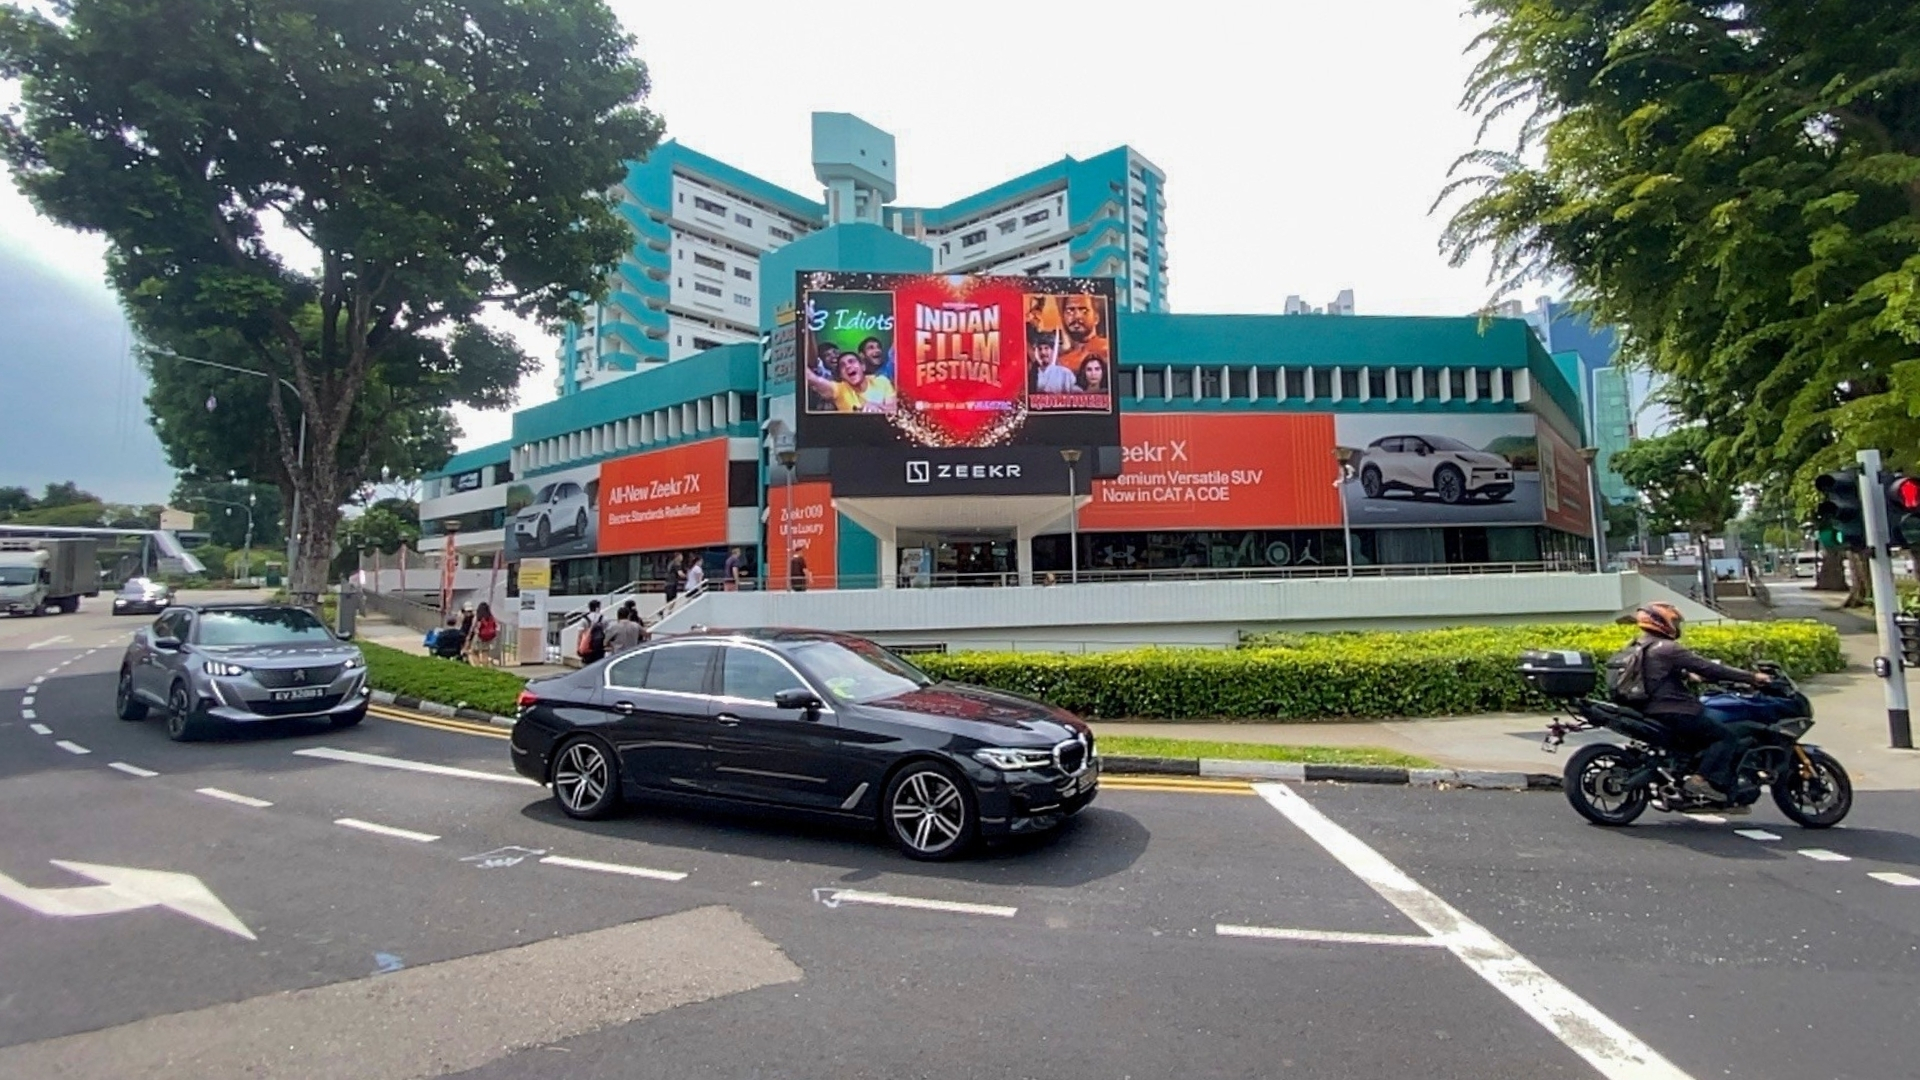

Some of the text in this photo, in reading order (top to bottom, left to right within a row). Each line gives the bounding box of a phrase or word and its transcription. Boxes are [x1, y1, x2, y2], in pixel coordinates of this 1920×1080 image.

[808, 309, 896, 331] 3 Idiots
[916, 303, 999, 333] INDIAN
[916, 330, 1000, 365] FILM
[916, 360, 1001, 388] FESTIVAL
[1121, 440, 1187, 462] eekr X
[938, 465, 1021, 478] ZEEKR
[1102, 469, 1263, 485] emium Versatile SUV
[608, 474, 700, 505] All-New Zeekr 7X
[1103, 486, 1230, 502] Now in CAT A COE
